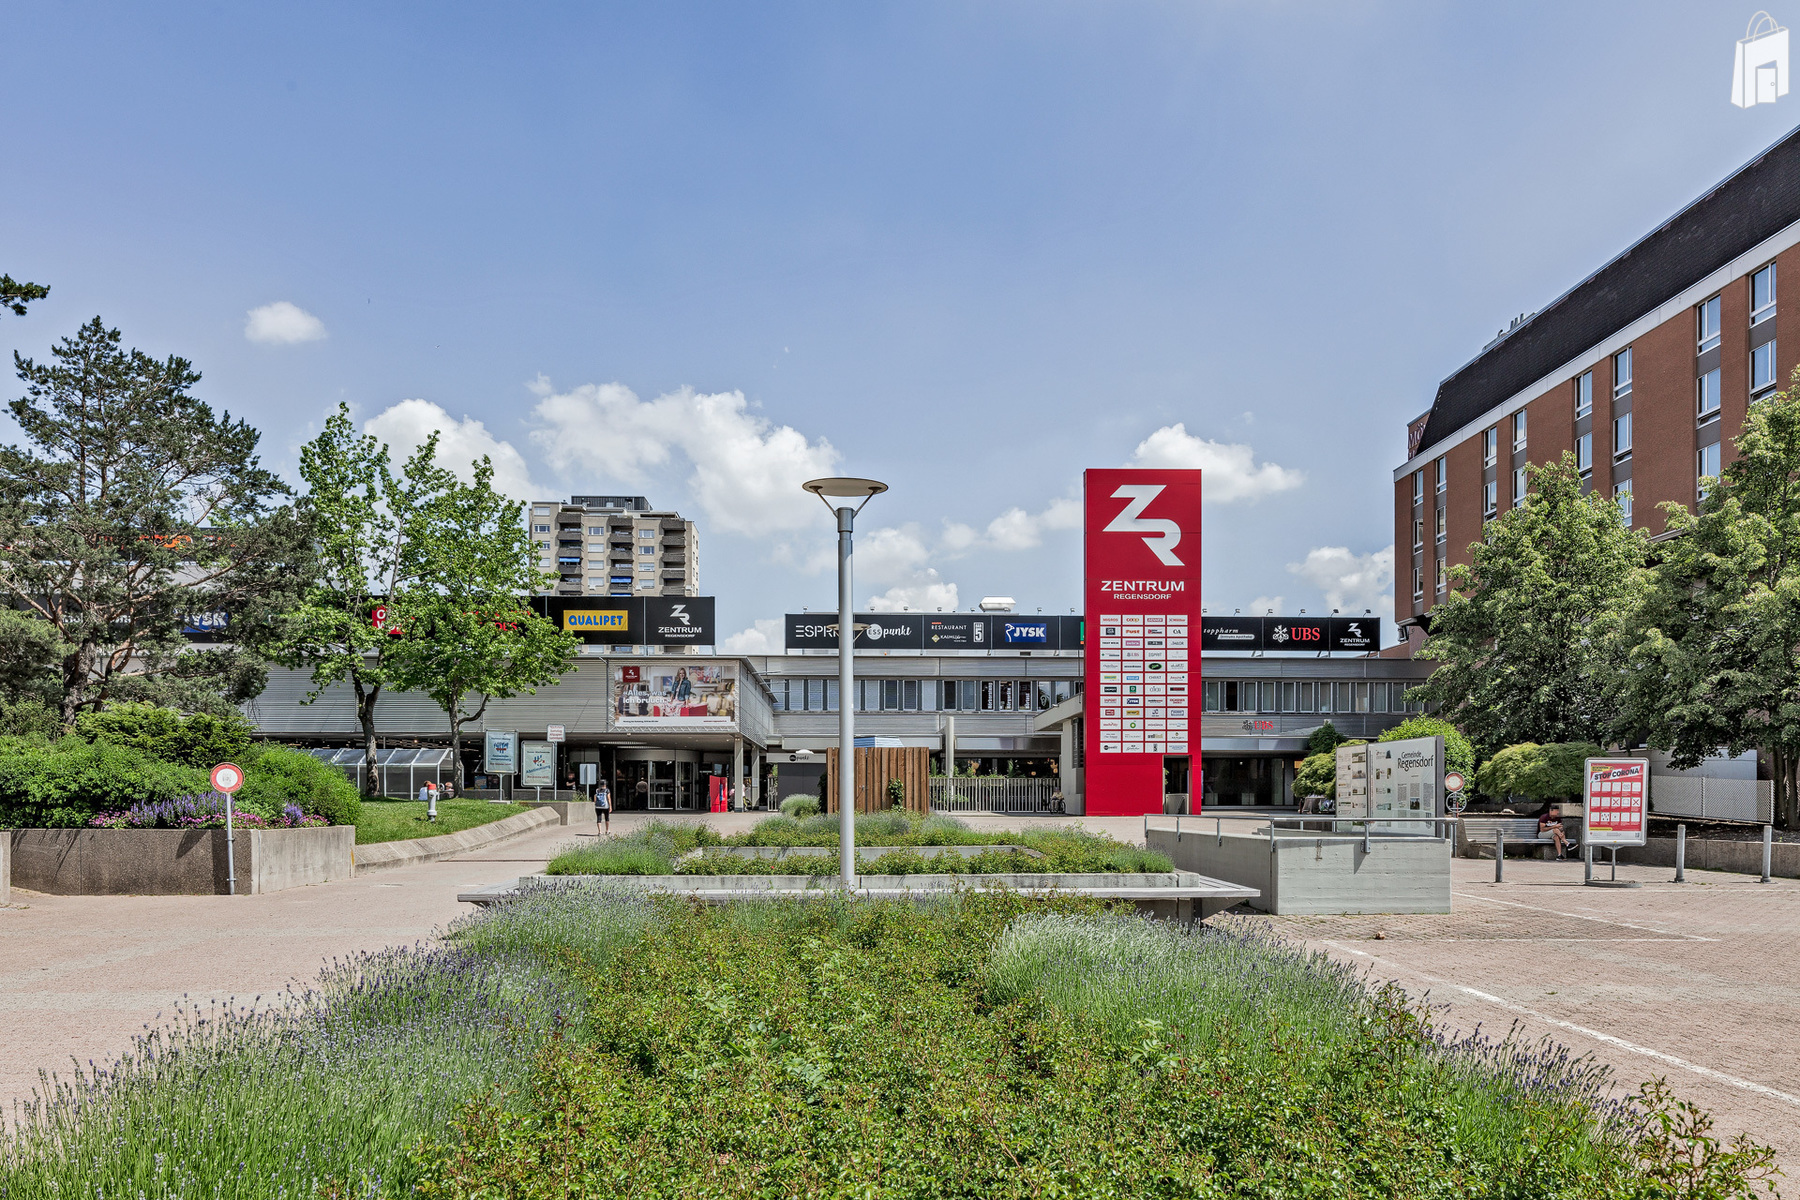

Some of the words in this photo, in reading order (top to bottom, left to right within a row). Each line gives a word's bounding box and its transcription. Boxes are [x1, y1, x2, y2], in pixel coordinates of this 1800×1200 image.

[1101, 581, 1185, 592] ZENTRUM
[568, 615, 624, 626] QUALIPET
[795, 625, 836, 637] ESPRI
[883, 624, 912, 638] punkt
[1014, 627, 1045, 637] JYSK
[1203, 627, 1239, 635] toppharm
[1291, 627, 1321, 641] UBS
[1254, 720, 1274, 730] UBS
[1401, 750, 1422, 759] Gemeinde
[1398, 754, 1434, 772] Regensdorf
[1594, 773, 1611, 781] STOP
[1612, 767, 1639, 778] CORONA
